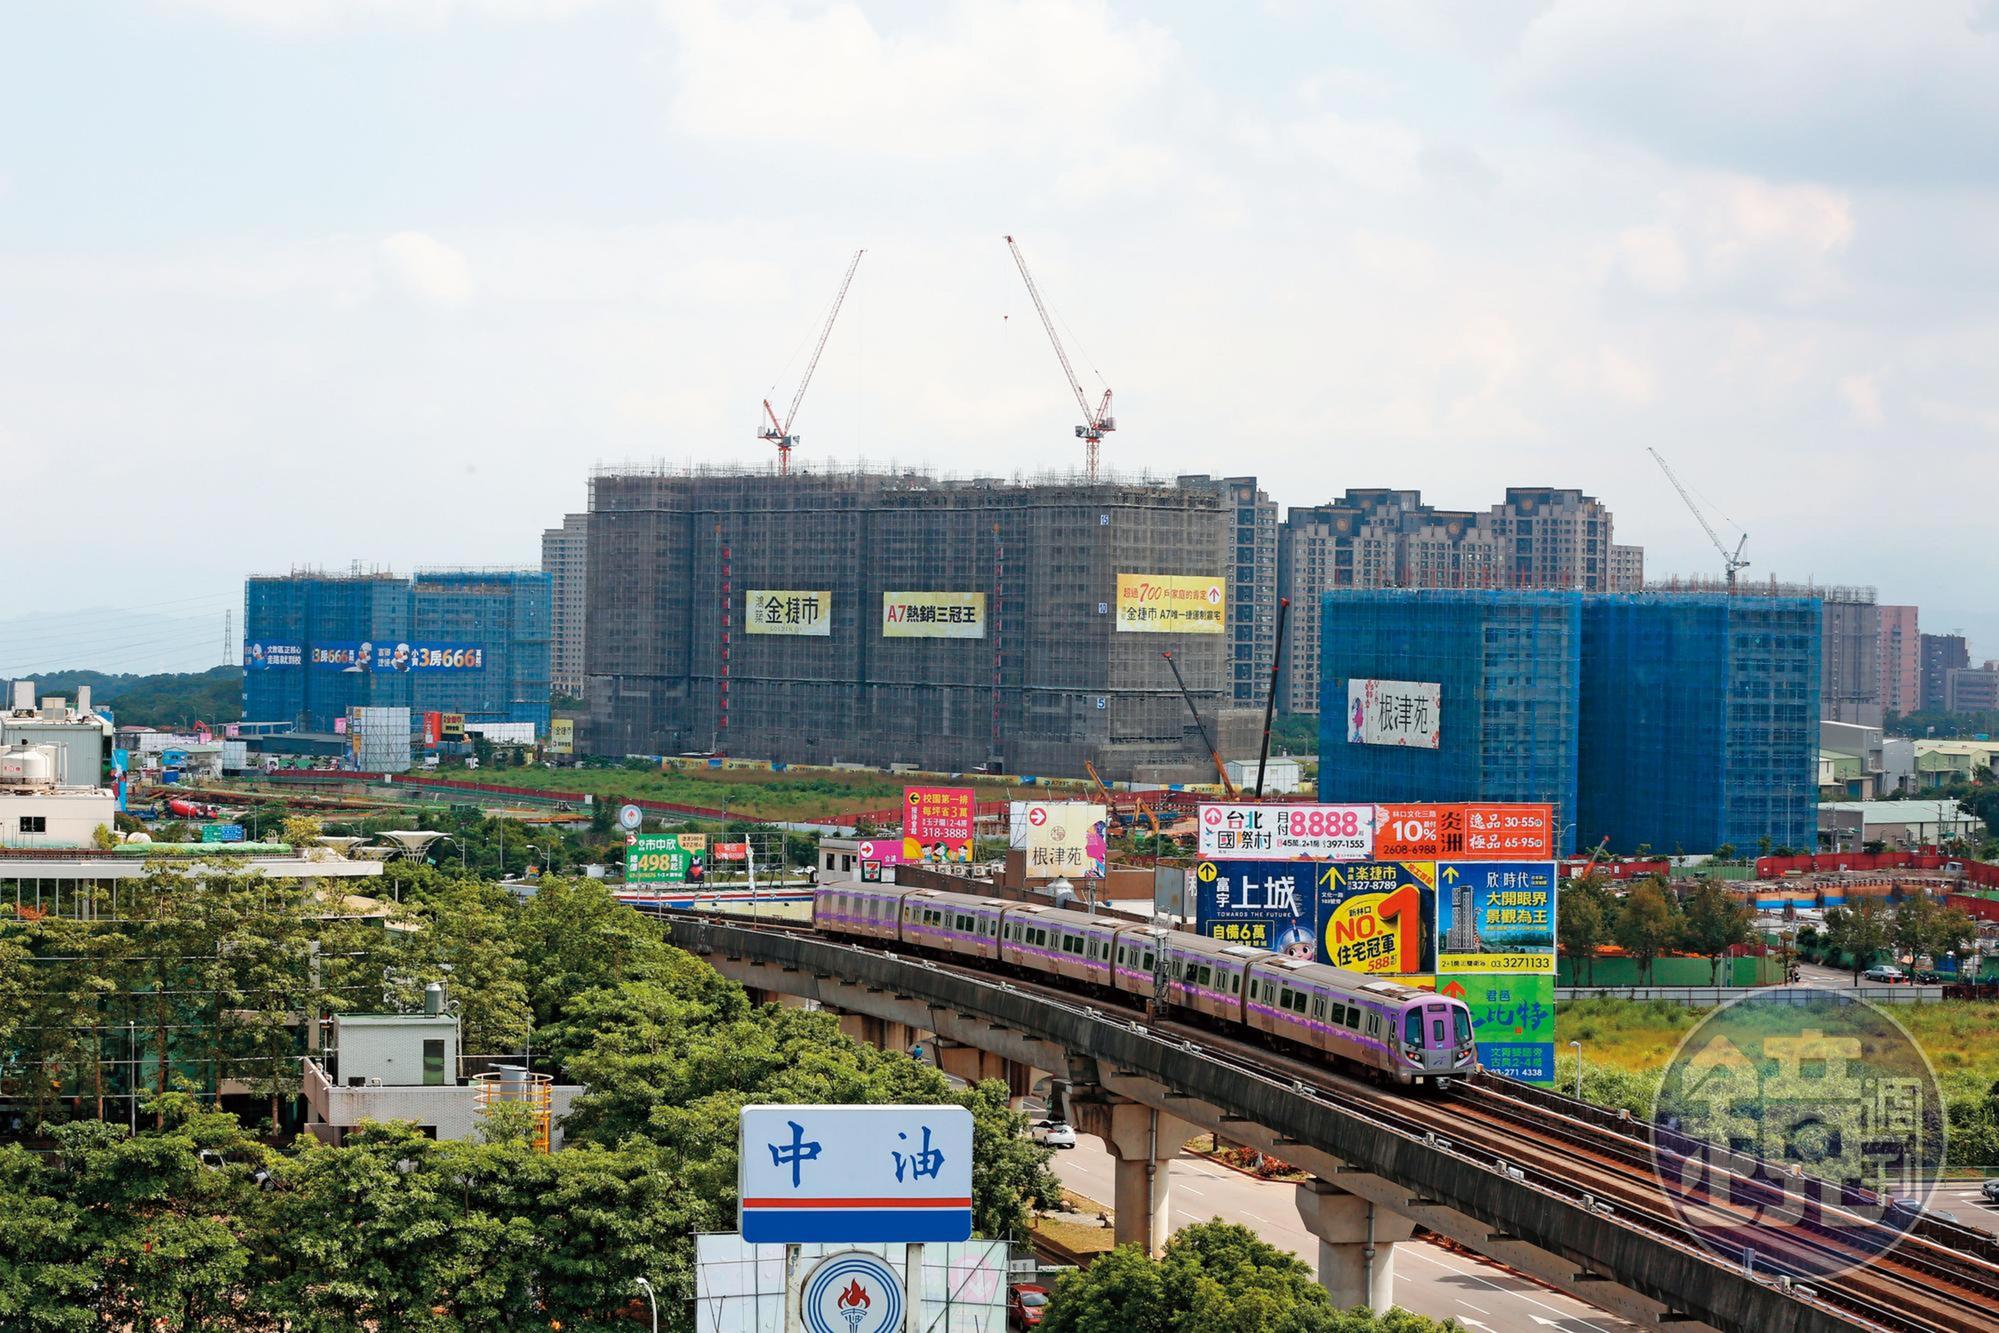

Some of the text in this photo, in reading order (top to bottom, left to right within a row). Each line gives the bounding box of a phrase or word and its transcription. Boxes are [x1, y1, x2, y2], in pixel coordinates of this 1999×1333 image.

[765, 596, 819, 624] 金捷市
[887, 605, 976, 623] A7熱銷三冠王
[1127, 607, 1157, 620] 金捷市
[1097, 698, 1105, 709] 5
[1379, 693, 1429, 734] 根津苑
[923, 794, 969, 805] 校園第一排
[922, 806, 968, 818] 每坪省3萬
[1227, 811, 1263, 830] 台北
[1470, 812, 1501, 829] 逸品
[1277, 812, 1289, 836] 月付
[1441, 811, 1463, 852] 炎洲
[922, 828, 968, 838] 318-3888
[1218, 831, 1272, 849] 國際村
[1470, 833, 1501, 849] 極品
[1326, 840, 1365, 848] 397-1555
[1383, 845, 1437, 855] 2608-6988
[639, 854, 671, 871] 498
[1032, 846, 1082, 866] 根津苑
[1351, 881, 1397, 890] 327-8789
[1487, 871, 1529, 888] 欣時代
[1216, 877, 1230, 908] 富宇
[1231, 875, 1300, 917] 上城
[1486, 891, 1548, 906] 大開眼界
[1349, 906, 1372, 917] 新林口
[1486, 909, 1548, 924] 景觀為王
[1213, 923, 1266, 940] 自備6萬
[1335, 885, 1420, 974] NO. 1
[1337, 934, 1395, 967] 住宅冠軍
[1367, 957, 1390, 972] 588
[1503, 958, 1550, 968] 3271133
[767, 1120, 946, 1188] 中油
